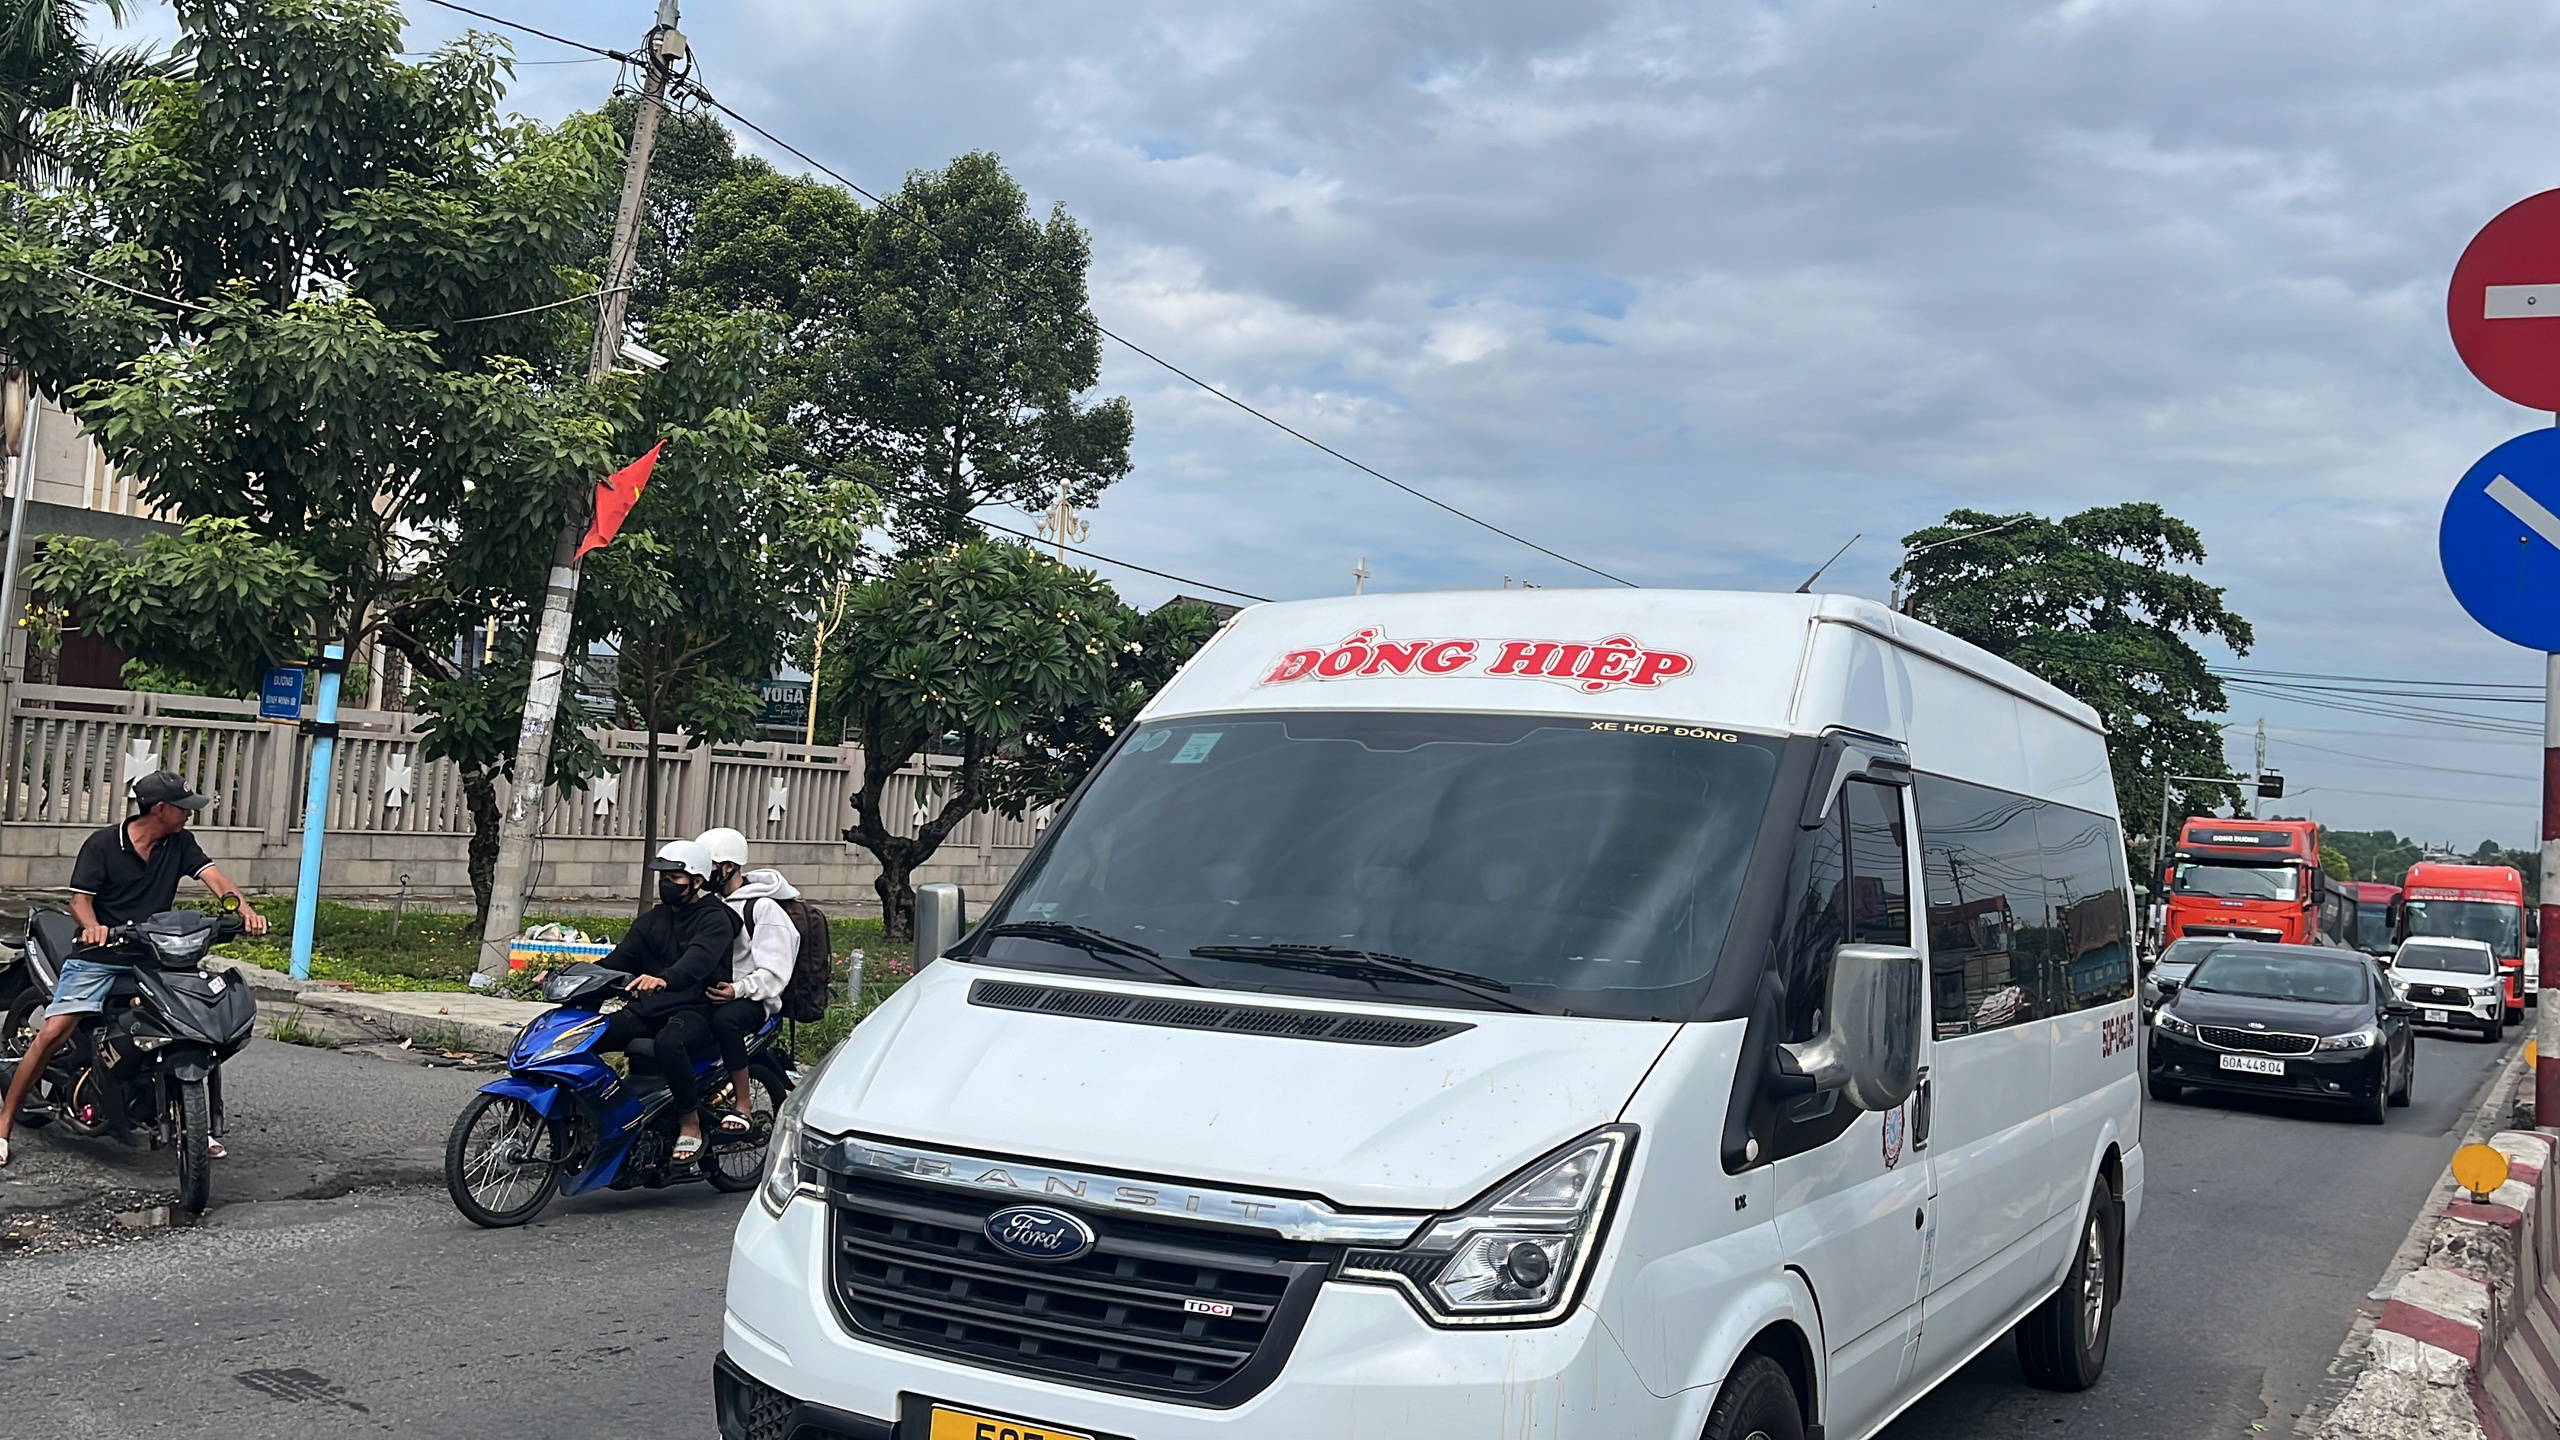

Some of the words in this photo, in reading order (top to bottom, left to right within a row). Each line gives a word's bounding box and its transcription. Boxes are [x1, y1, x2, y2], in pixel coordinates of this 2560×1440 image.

[1261, 626, 1479, 686] ĐỒNG
[1486, 633, 1695, 693] HIỆP
[763, 686, 805, 704] YOGA
[1590, 721, 1619, 731] XE
[1623, 723, 1669, 735] HỢP
[1673, 727, 1739, 743] ĐỒNG
[862, 1148, 1278, 1220] TRANSIT
[1003, 1213, 1066, 1250] Ford
[1187, 1300, 1230, 1315] TDCi
